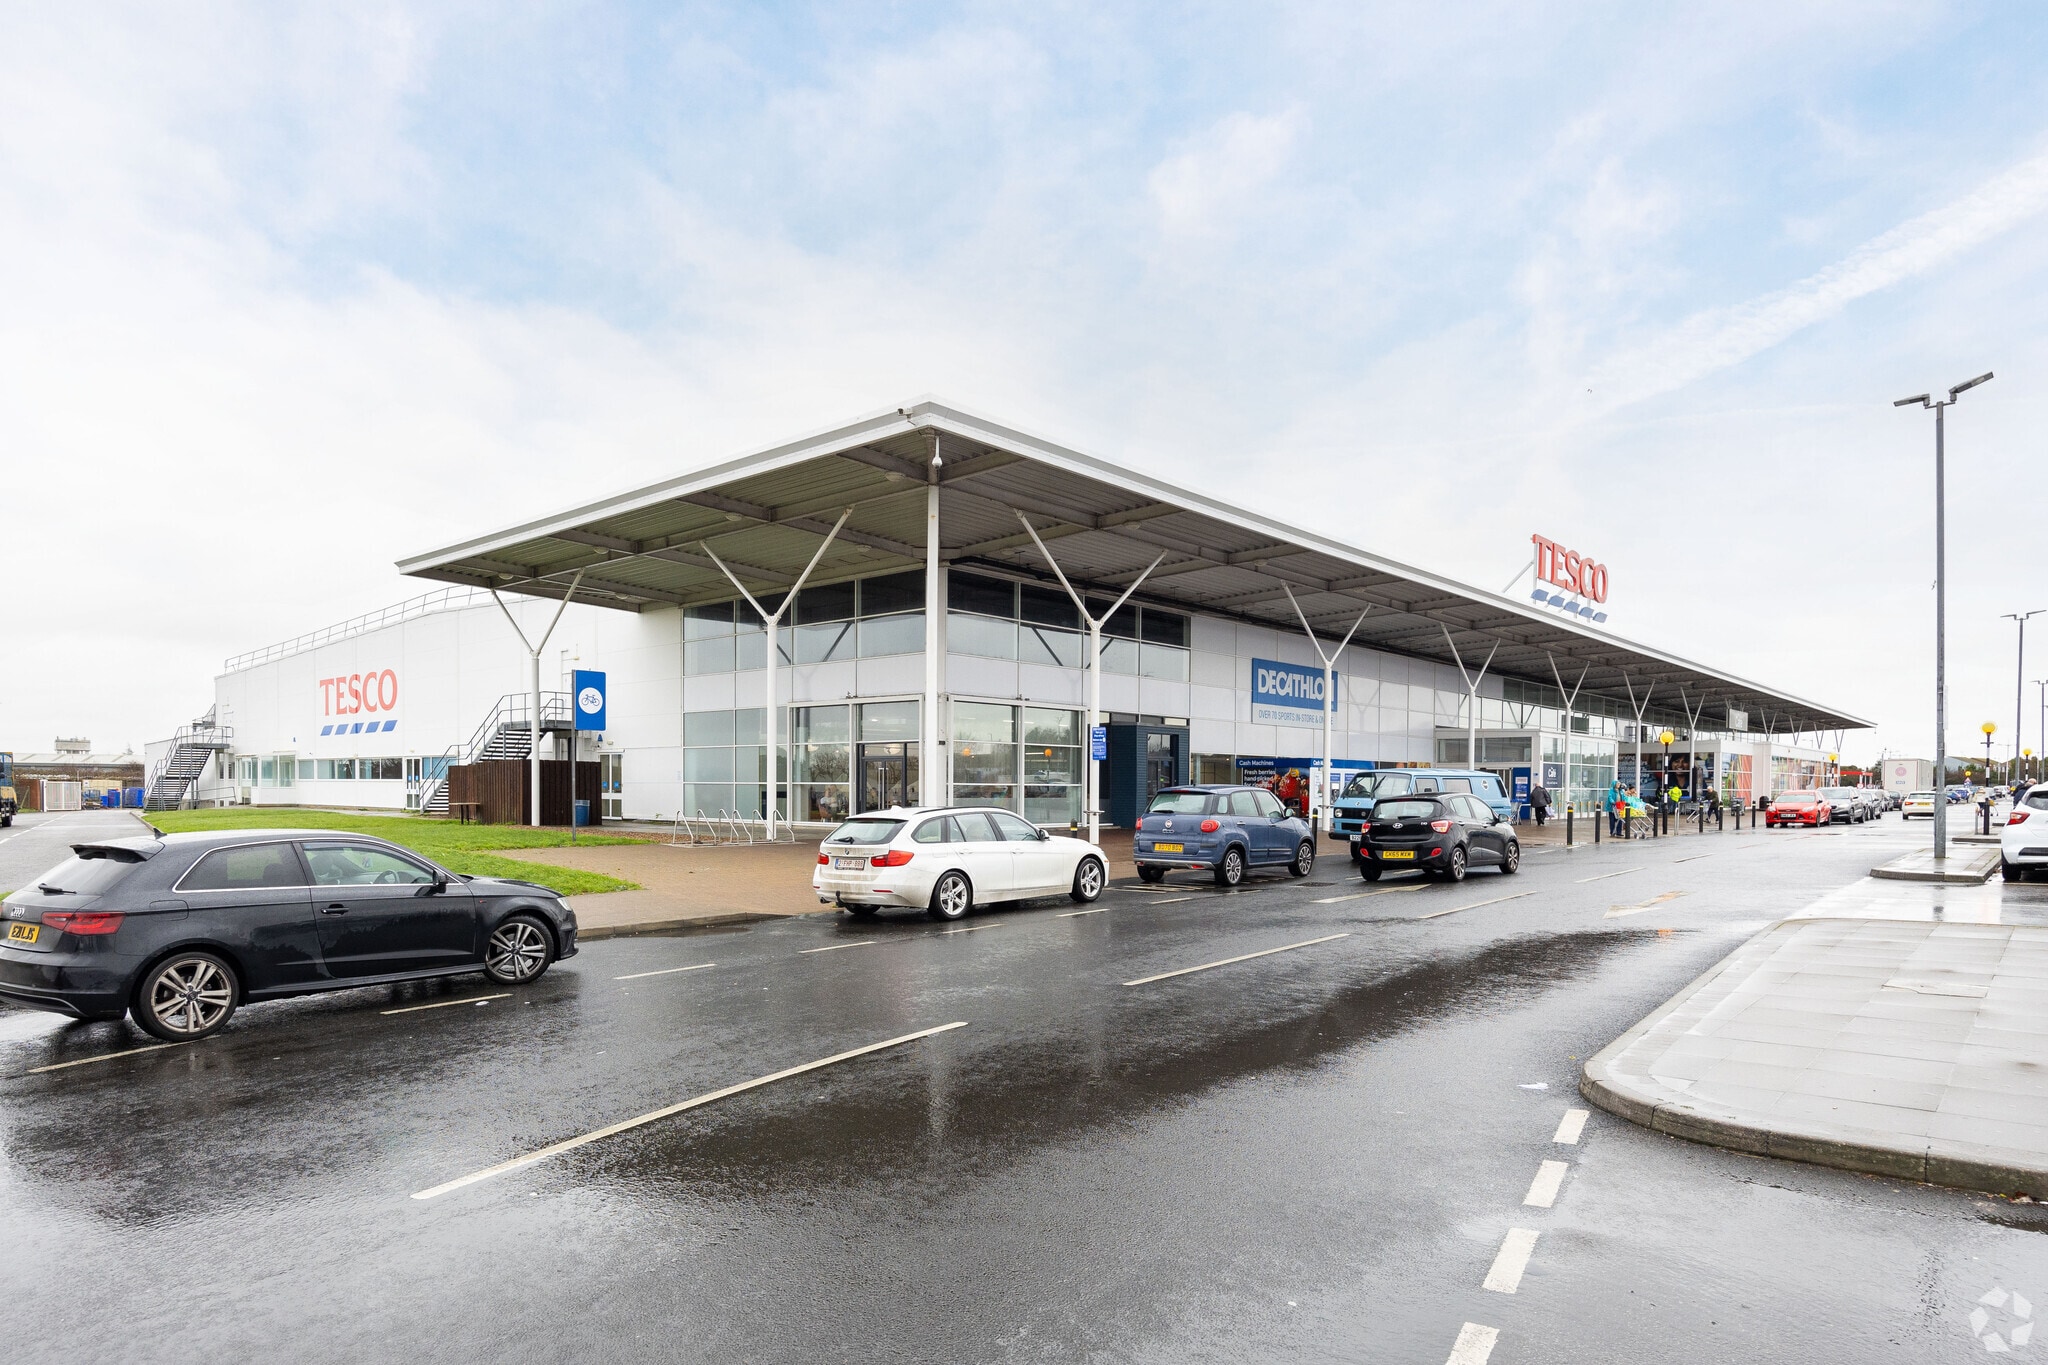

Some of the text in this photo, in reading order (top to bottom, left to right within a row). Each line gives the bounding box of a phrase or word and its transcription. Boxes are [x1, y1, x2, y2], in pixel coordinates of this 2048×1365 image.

[1532, 533, 1609, 604] TESCO
[319, 668, 398, 717] TESCO
[1258, 709, 1271, 719] OVER
[1271, 710, 1278, 720] 70
[1277, 711, 1295, 722] SPORTS
